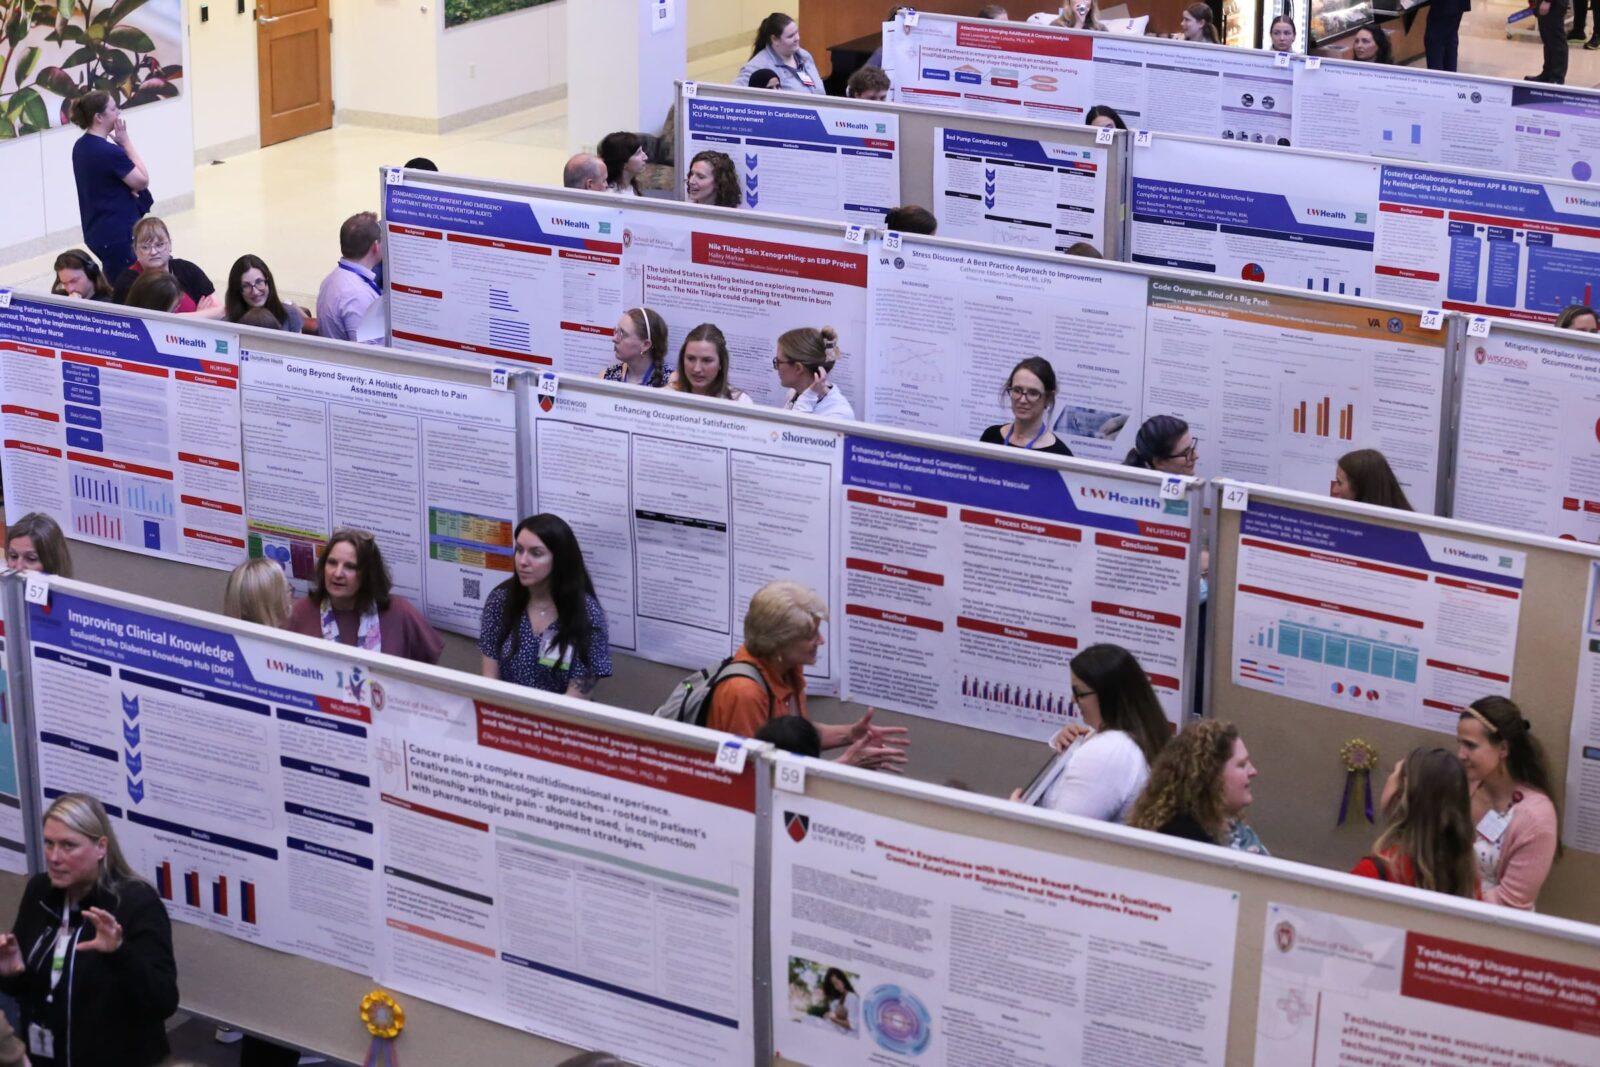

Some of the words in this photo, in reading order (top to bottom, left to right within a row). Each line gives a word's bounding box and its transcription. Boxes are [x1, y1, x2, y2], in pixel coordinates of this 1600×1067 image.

[687, 86, 694, 94] 19
[1457, 92, 1466, 100] VA
[692, 103, 718, 113] Duplicate
[720, 106, 734, 115] Type
[774, 111, 816, 120] Cardiothoracic
[726, 114, 763, 122] Improvement
[971, 137, 1000, 145] Compliance
[1100, 133, 1110, 141] 20
[1138, 133, 1148, 142] 21
[390, 174, 400, 183] 31
[1384, 169, 1413, 180] Fostering
[1414, 173, 1456, 183] Collaboration
[1457, 178, 1485, 187] Between
[1519, 186, 1539, 194] Teams
[1383, 178, 1391, 186] by
[1392, 180, 1430, 191] Reimagining
[1431, 184, 1448, 193] Daily
[1449, 186, 1472, 195] Rounds
[1307, 208, 1346, 220] UWHealth
[552, 217, 590, 230] UWHealth
[847, 232, 858, 241] 32
[886, 239, 899, 248] 33
[722, 244, 744, 253] Tilapia
[760, 250, 806, 263] Xenografting:
[831, 259, 856, 268] Project
[912, 250, 930, 258] Stress
[988, 261, 1014, 270] Practice
[1015, 265, 1047, 275] Approach
[1057, 271, 1102, 283] Improvement
[659, 267, 680, 275] United
[682, 270, 702, 278] States
[710, 273, 730, 283] falling
[731, 277, 754, 285] behind
[764, 283, 795, 292] exploring
[796, 287, 833, 296] non-human
[646, 274, 677, 283] biological
[678, 278, 716, 288] alternatives
[742, 288, 769, 297] grafting
[770, 291, 807, 301] treatments
[815, 297, 831, 305] burn
[700, 289, 721, 298] Tilapia
[741, 296, 764, 305] change
[1152, 282, 1171, 290] Code
[1239, 295, 1251, 305] Big
[1368, 318, 1380, 328] VA
[1422, 316, 1435, 326] 34
[1472, 323, 1485, 333] 35
[166, 334, 206, 349] UWHealth
[286, 364, 307, 376] Going
[308, 368, 335, 378] Beyond
[375, 379, 401, 390] Holistic
[403, 384, 439, 395] Approach
[441, 389, 449, 397] to
[450, 390, 467, 399] Pain
[493, 376, 505, 385] 44
[542, 382, 555, 392] 45
[350, 385, 397, 399] Assessments
[614, 404, 650, 418] Enhancing
[652, 410, 700, 423] Occupational
[782, 431, 836, 448] Shorewood
[1163, 483, 1179, 495] 46
[1081, 486, 1160, 509] UWHealth
[1227, 491, 1244, 503] 47
[1146, 526, 1187, 538] NURSING
[30, 585, 44, 599] 57
[68, 610, 124, 636] Improving
[126, 624, 166, 643] Clinical
[169, 635, 234, 660] Knowledge
[70, 628, 105, 646] Evaluating
[106, 638, 118, 648] the
[119, 641, 151, 656] Diabetes
[152, 650, 192, 667] Knowledge
[193, 660, 210, 670] Hub
[211, 664, 234, 677] (DKH)
[266, 658, 324, 681] UWHealth
[720, 748, 737, 764] 58
[408, 743, 440, 758] Cancer
[443, 754, 464, 764] pain
[465, 759, 473, 767] is
[483, 764, 524, 778] complex
[526, 774, 611, 800] multidimensional
[612, 796, 671, 815] experience.
[781, 769, 799, 783] 59
[409, 756, 448, 773] Creative
[451, 769, 544, 797] non-pharmacologic
[547, 793, 604, 812] approaches
[613, 809, 647, 823] rooted
[649, 817, 658, 826] in
[660, 822, 706, 838] patient's
[410, 771, 465, 791] relationship
[467, 787, 488, 796] with
[490, 790, 512, 802] their
[515, 798, 536, 808] pain
[545, 805, 578, 819] should
[580, 812, 592, 822] be
[594, 818, 620, 830] used,
[624, 824, 634, 833] in
[636, 829, 696, 849] conjunction
[411, 784, 430, 793] with
[432, 790, 501, 813] pharmacologic
[503, 808, 524, 818] pain
[526, 814, 590, 835] management
[593, 831, 645, 849] strategies.
[812, 822, 866, 844] EDGEWOOD
